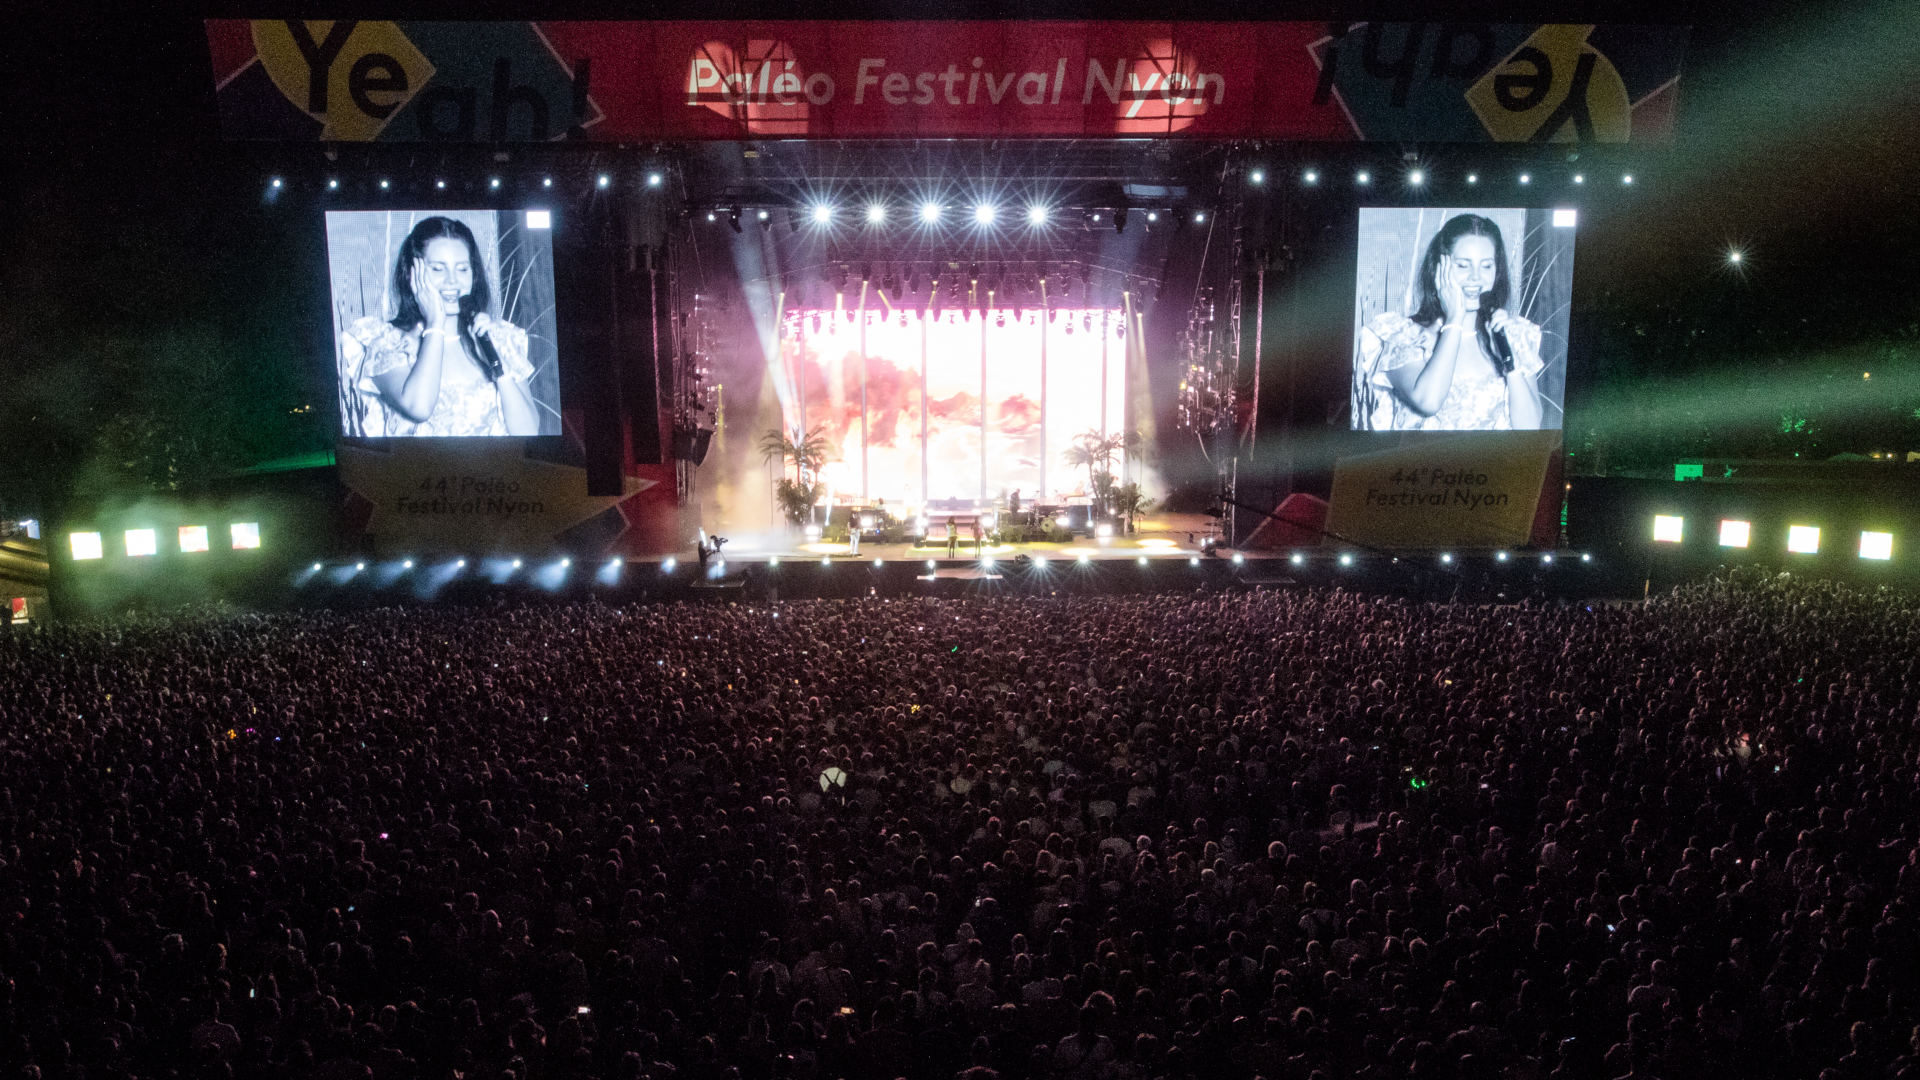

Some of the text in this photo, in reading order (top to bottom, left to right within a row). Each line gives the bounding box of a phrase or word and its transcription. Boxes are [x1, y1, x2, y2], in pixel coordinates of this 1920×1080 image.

[285, 19, 590, 140] Yeah!
[687, 55, 1226, 118] Paléo Festival Nyon
[1431, 466, 1489, 486] Paléo
[396, 495, 545, 519] Festival Nyon
[1365, 488, 1509, 511] Festival Nyon
